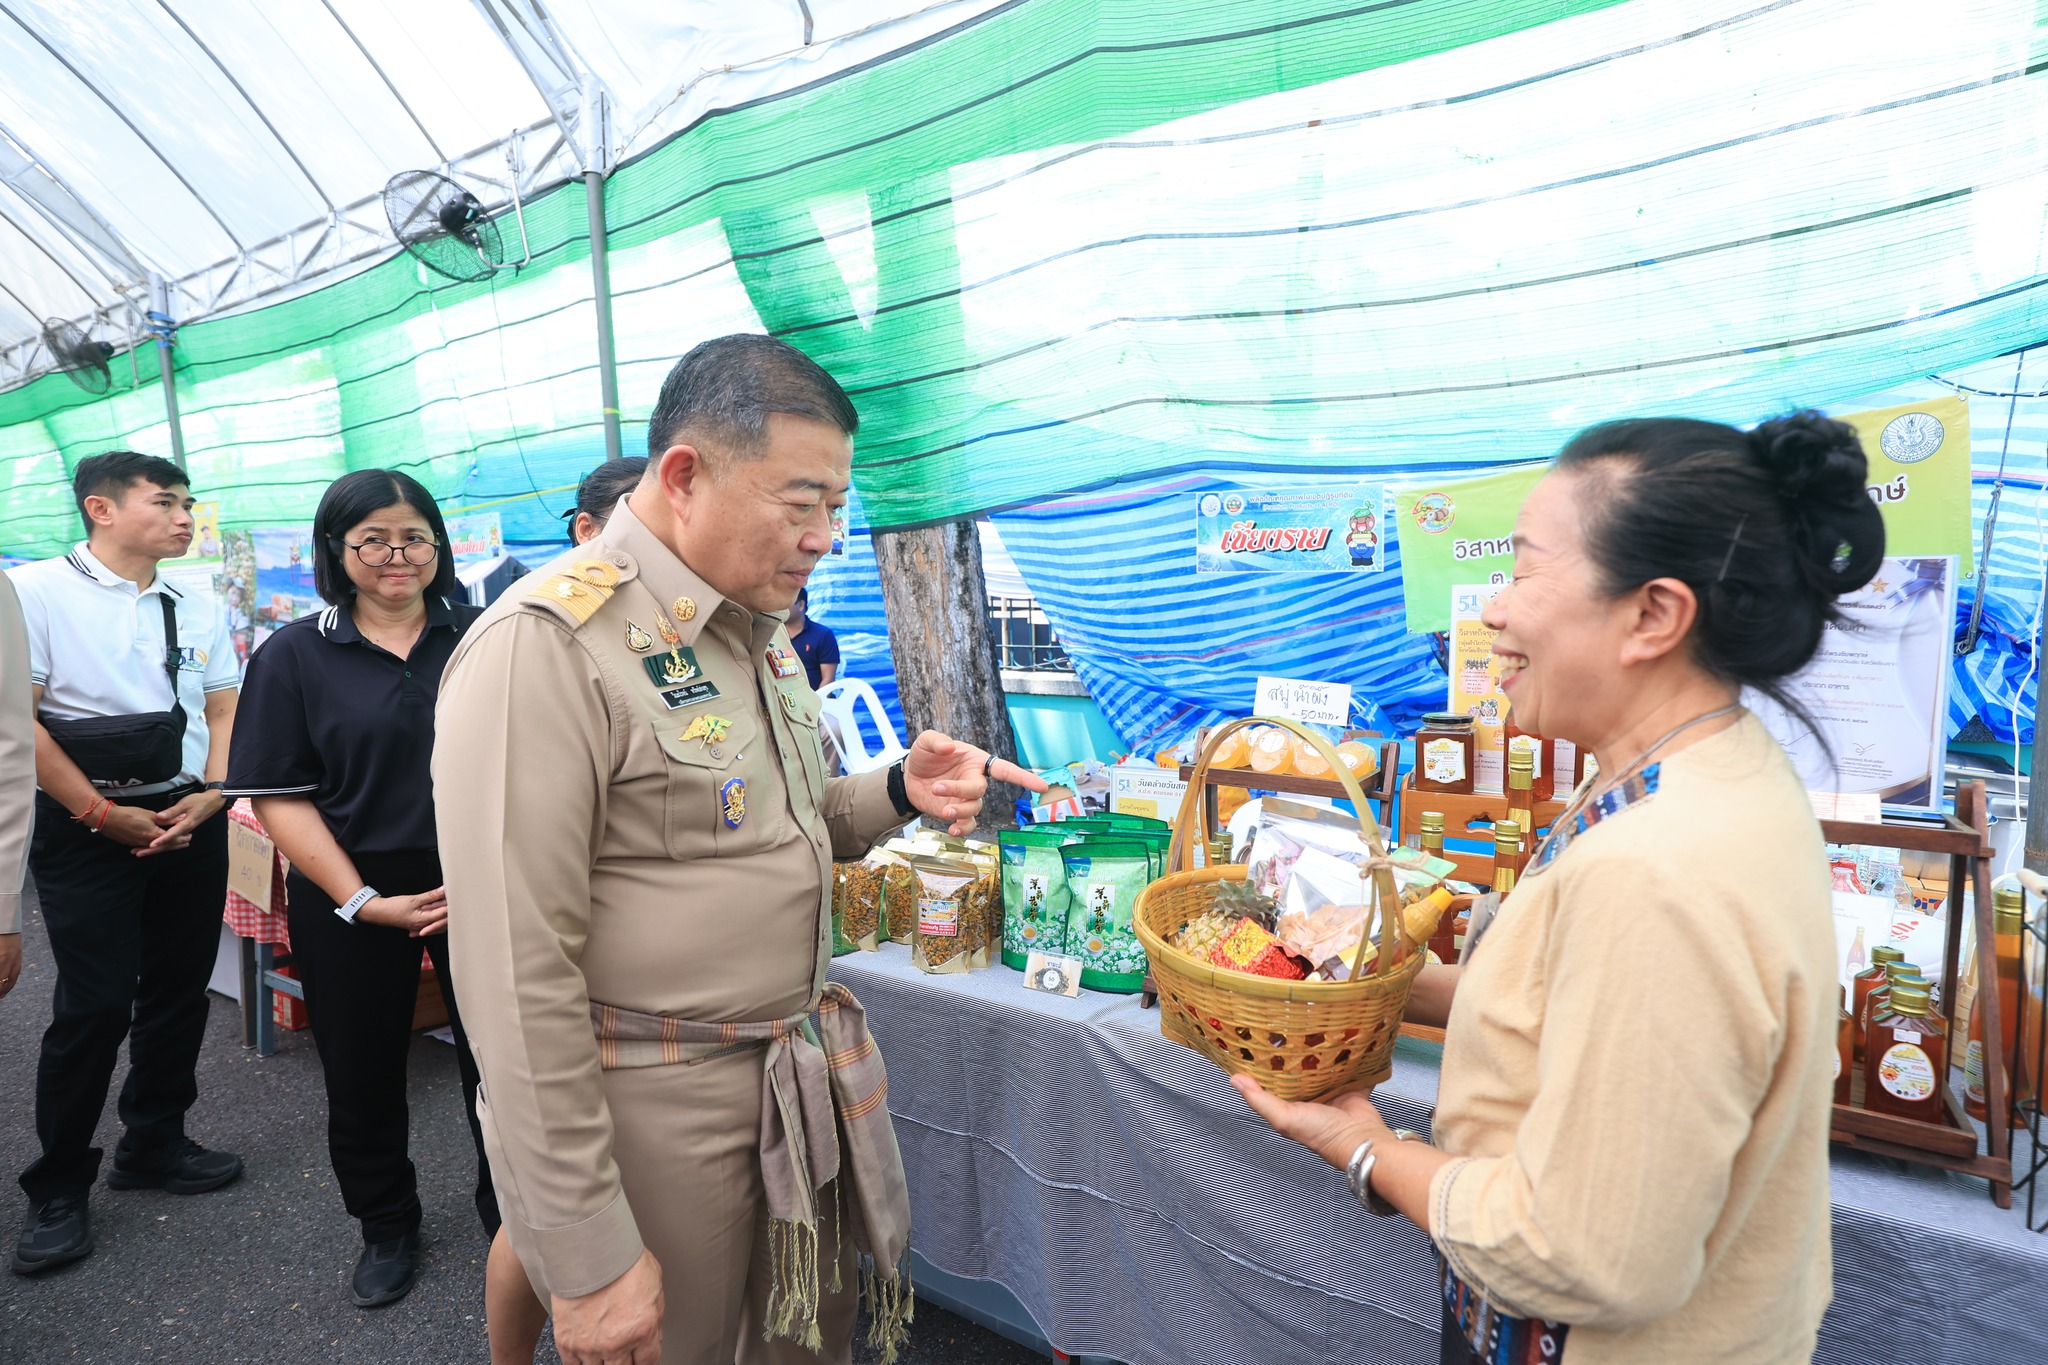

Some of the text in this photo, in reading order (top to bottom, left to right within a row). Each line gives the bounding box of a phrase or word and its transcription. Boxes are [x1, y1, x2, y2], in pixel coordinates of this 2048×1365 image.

[1220, 520, 1333, 552] เชียงราย
[1118, 779, 1131, 791] 51
